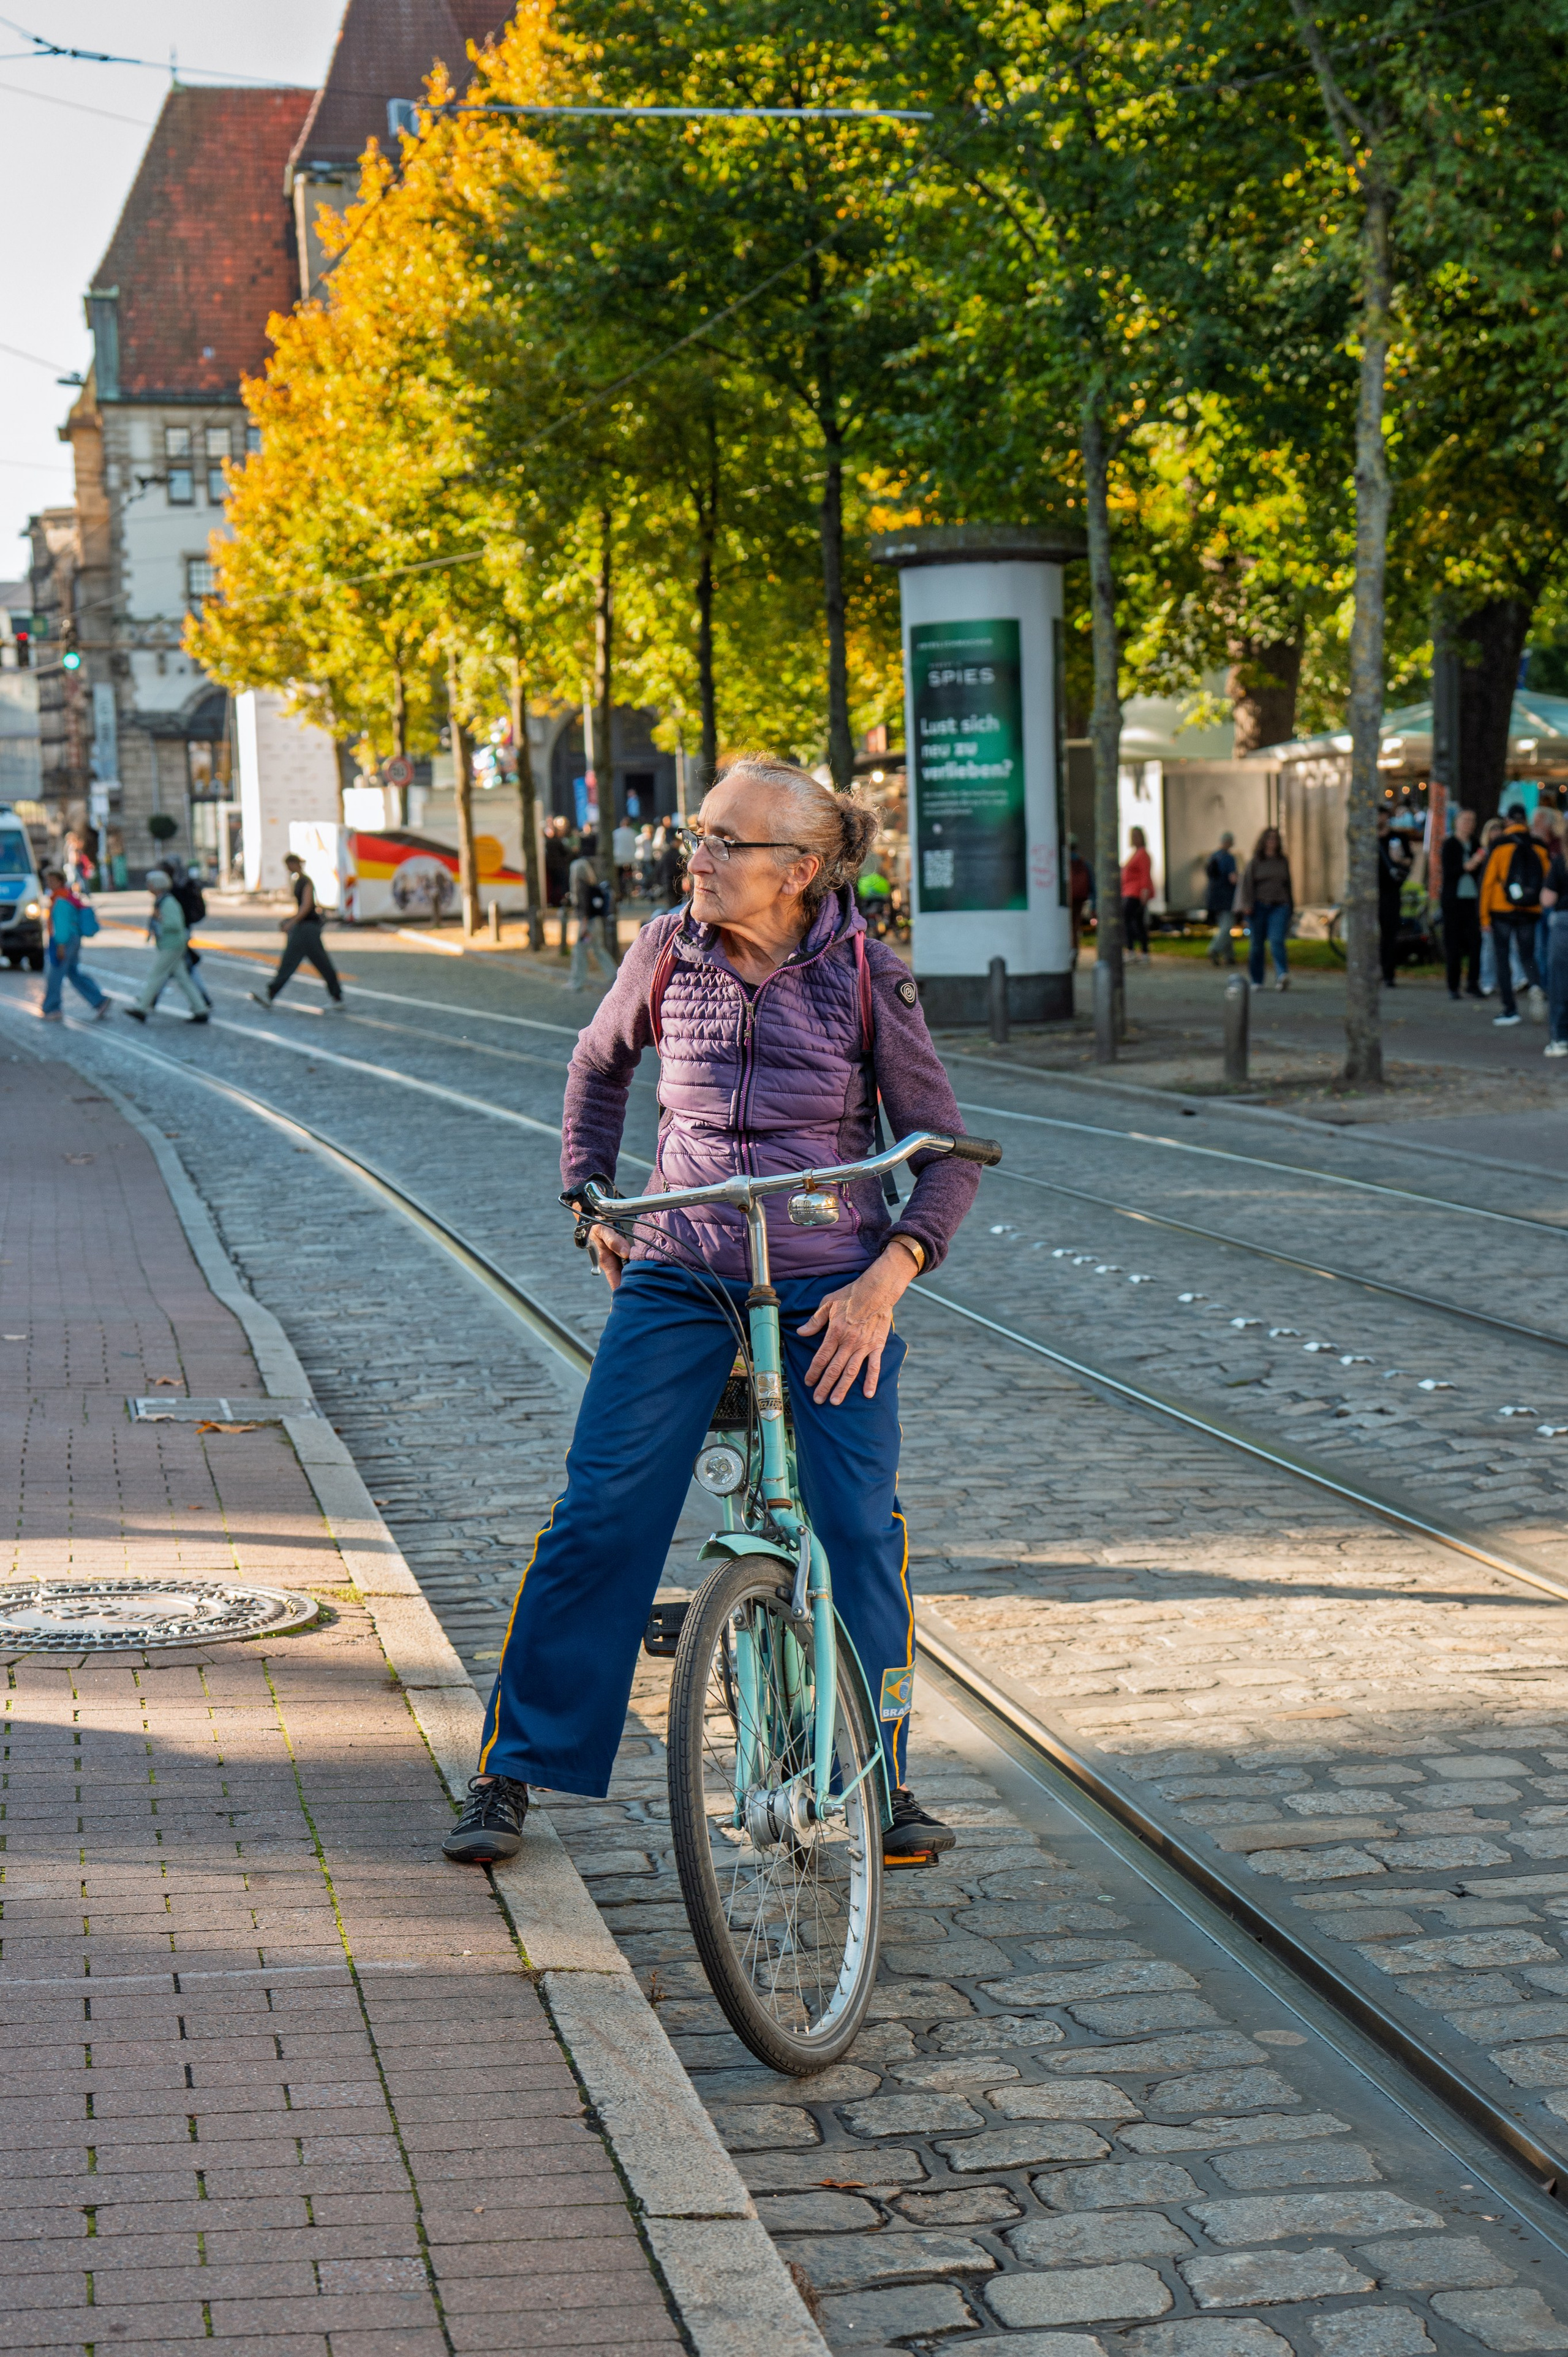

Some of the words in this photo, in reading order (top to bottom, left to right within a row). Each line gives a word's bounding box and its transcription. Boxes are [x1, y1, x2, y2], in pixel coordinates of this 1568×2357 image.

[928, 667, 995, 687] SPIES
[920, 717, 958, 736] Lust
[960, 713, 1000, 733] sich
[921, 743, 951, 760] neu
[954, 741, 978, 757] zu
[921, 759, 1014, 781] verlieben?
